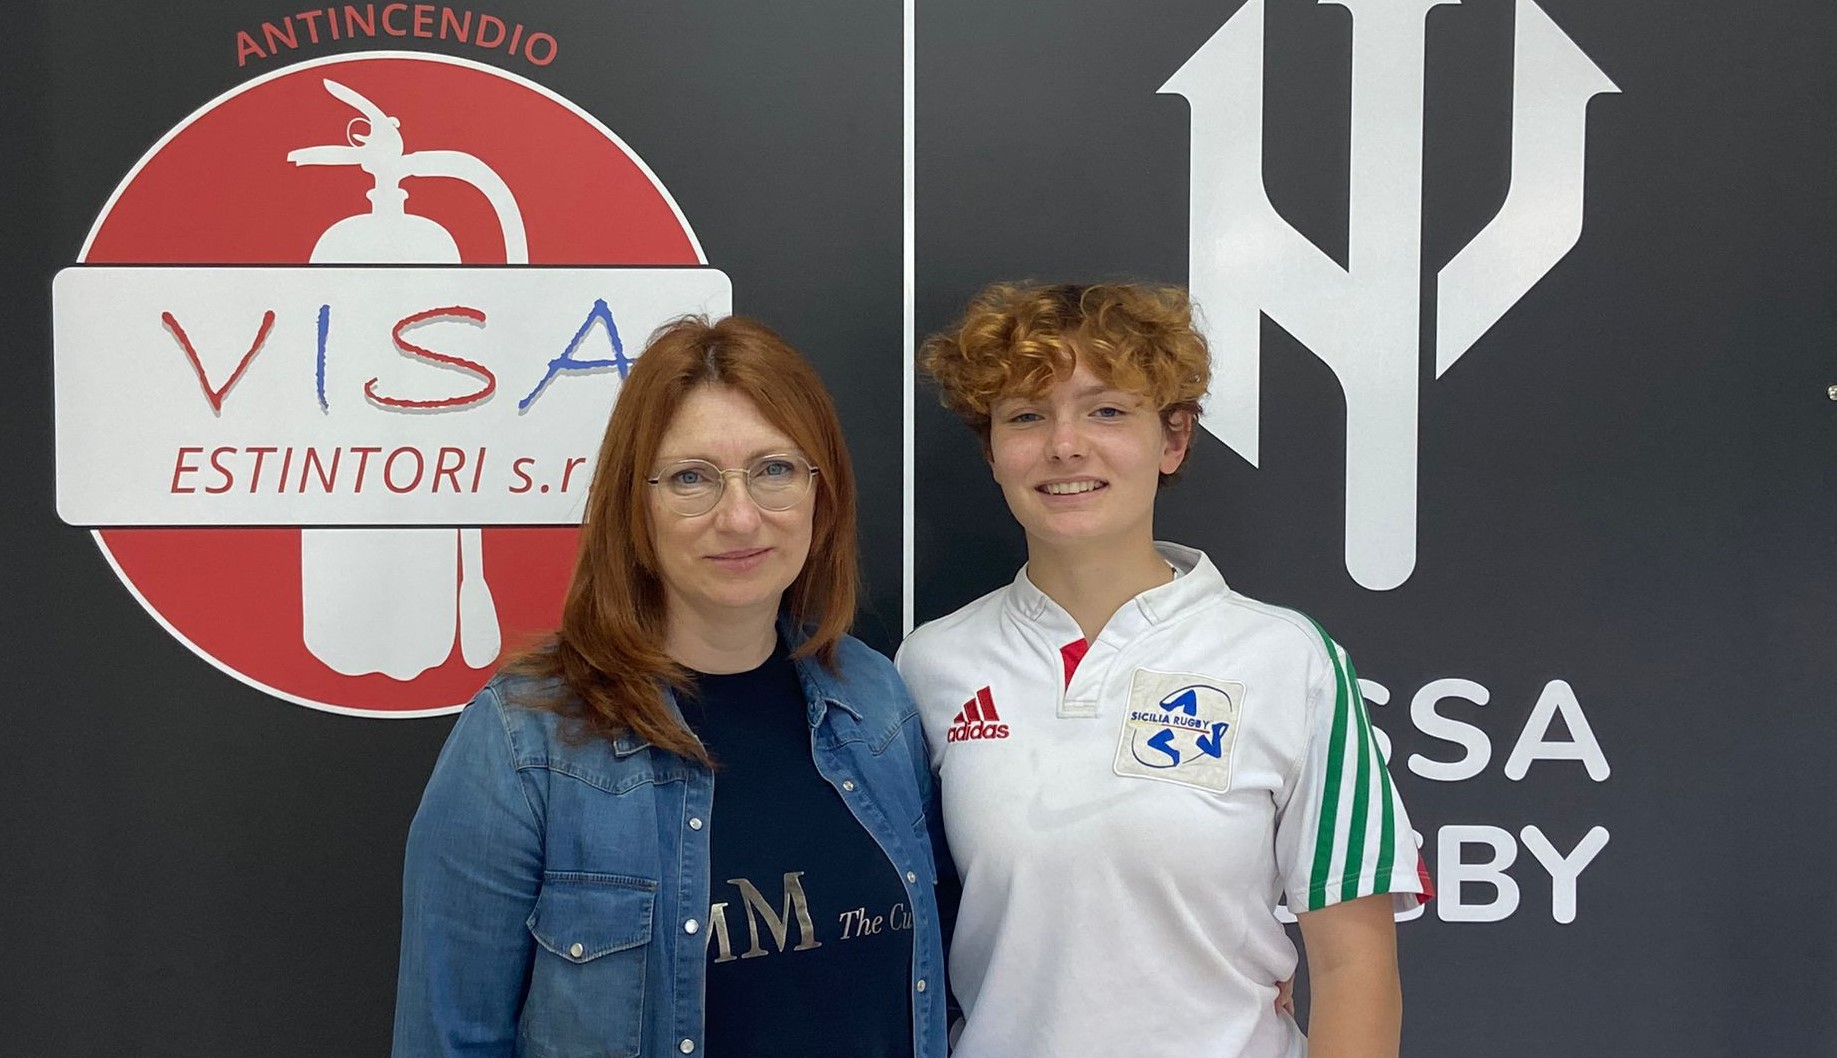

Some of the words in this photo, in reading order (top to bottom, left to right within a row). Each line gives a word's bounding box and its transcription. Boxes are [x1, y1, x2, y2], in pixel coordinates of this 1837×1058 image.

[236, 3, 559, 67] ANTINCENDIO
[162, 298, 636, 415] VISA
[170, 446, 487, 494] ESTINTORI
[947, 721, 1010, 743] adidas
[1131, 711, 1170, 724] SICILIA
[1173, 716, 1209, 730] RUGBY
[839, 907, 883, 940] The
